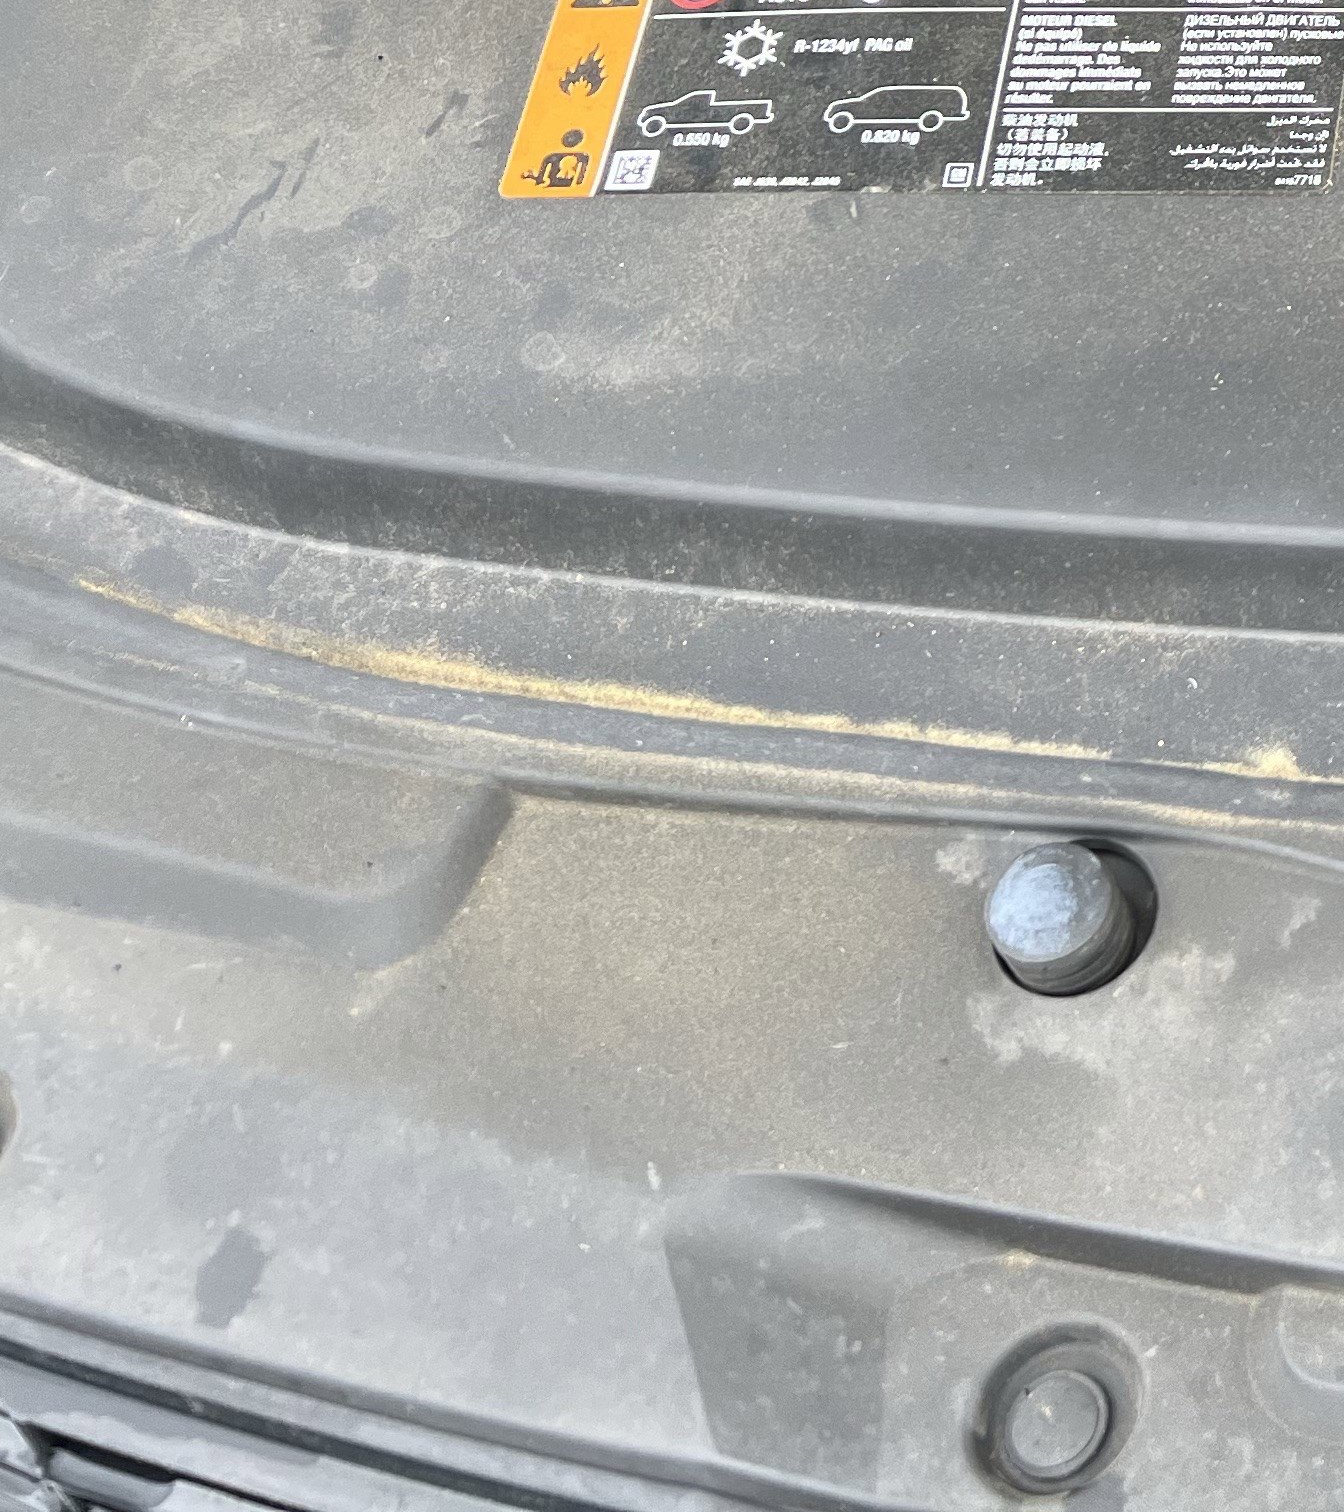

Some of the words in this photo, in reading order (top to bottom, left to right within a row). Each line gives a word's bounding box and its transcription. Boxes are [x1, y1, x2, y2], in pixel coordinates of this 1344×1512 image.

[1020, 14, 1073, 26] MOTEUR
[1073, 14, 1118, 26] DIESEL
[1184, 12, 1265, 27] ДИЗЕЛЬНЫЙ
[1265, 14, 1341, 27] ДВИГАТЕЛЬ
[1183, 27, 1216, 40] (если
[793, 38, 860, 55] R-1234yf
[864, 38, 893, 52] PAG
[894, 38, 914, 52] oil
[1015, 41, 1033, 52] Ne
[1034, 42, 1058, 53] pas
[1102, 40, 1119, 52] de
[1120, 40, 1162, 54] liquide
[1180, 40, 1198, 52] Не
[1199, 39, 1273, 54] используйте
[1096, 53, 1121, 64] Des
[1235, 55, 1259, 66] для
[1260, 55, 1322, 66] холодного
[1010, 66, 1077, 80] dommages
[1025, 79, 1070, 91] moteur
[1134, 81, 1151, 91] en
[1001, 113, 1079, 127] 柴油发动机
[711, 132, 730, 148] kg
[901, 129, 920, 146] kg
